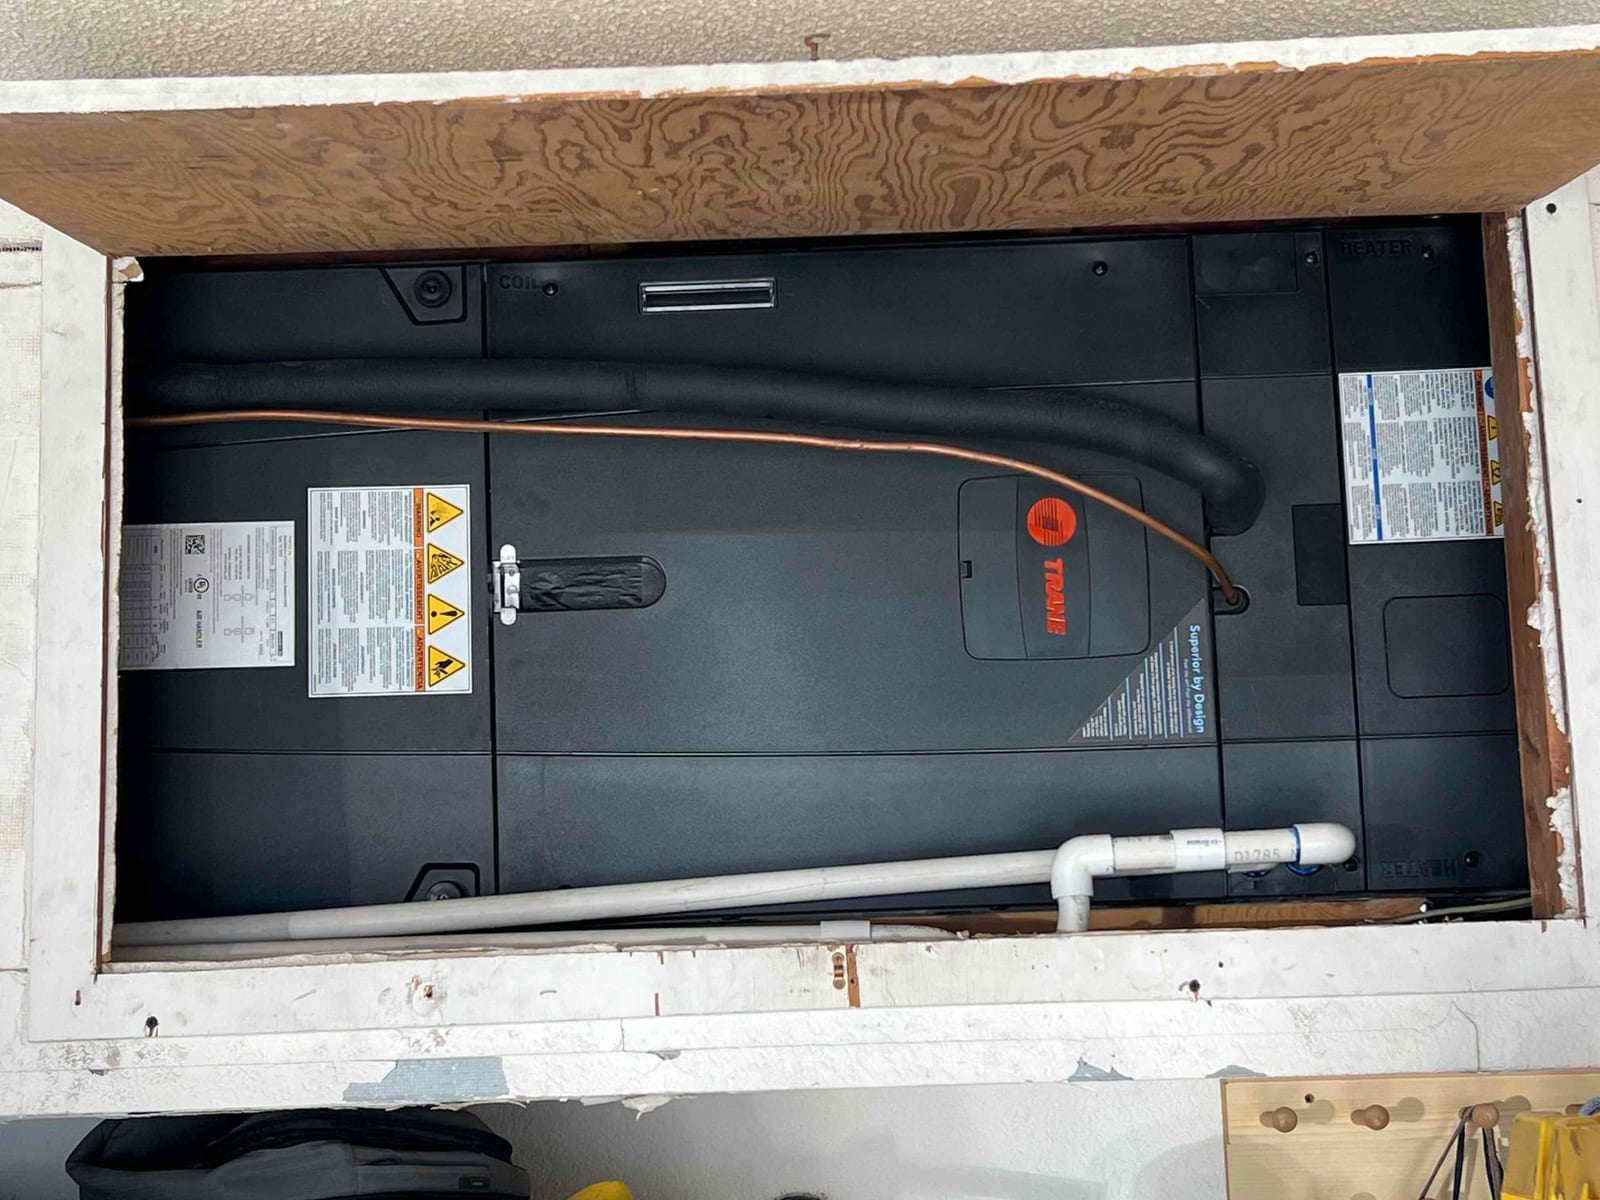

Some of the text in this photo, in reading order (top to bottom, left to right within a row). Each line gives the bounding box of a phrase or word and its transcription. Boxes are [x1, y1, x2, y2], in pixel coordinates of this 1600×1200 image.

[1341, 239, 1412, 257] HEATER
[499, 274, 543, 289] COIL
[1044, 558, 1066, 635] TRANE
[1188, 625, 1206, 733] Superior by Design
[1234, 848, 1281, 862] D1785
[1381, 859, 1457, 879] HEATER
